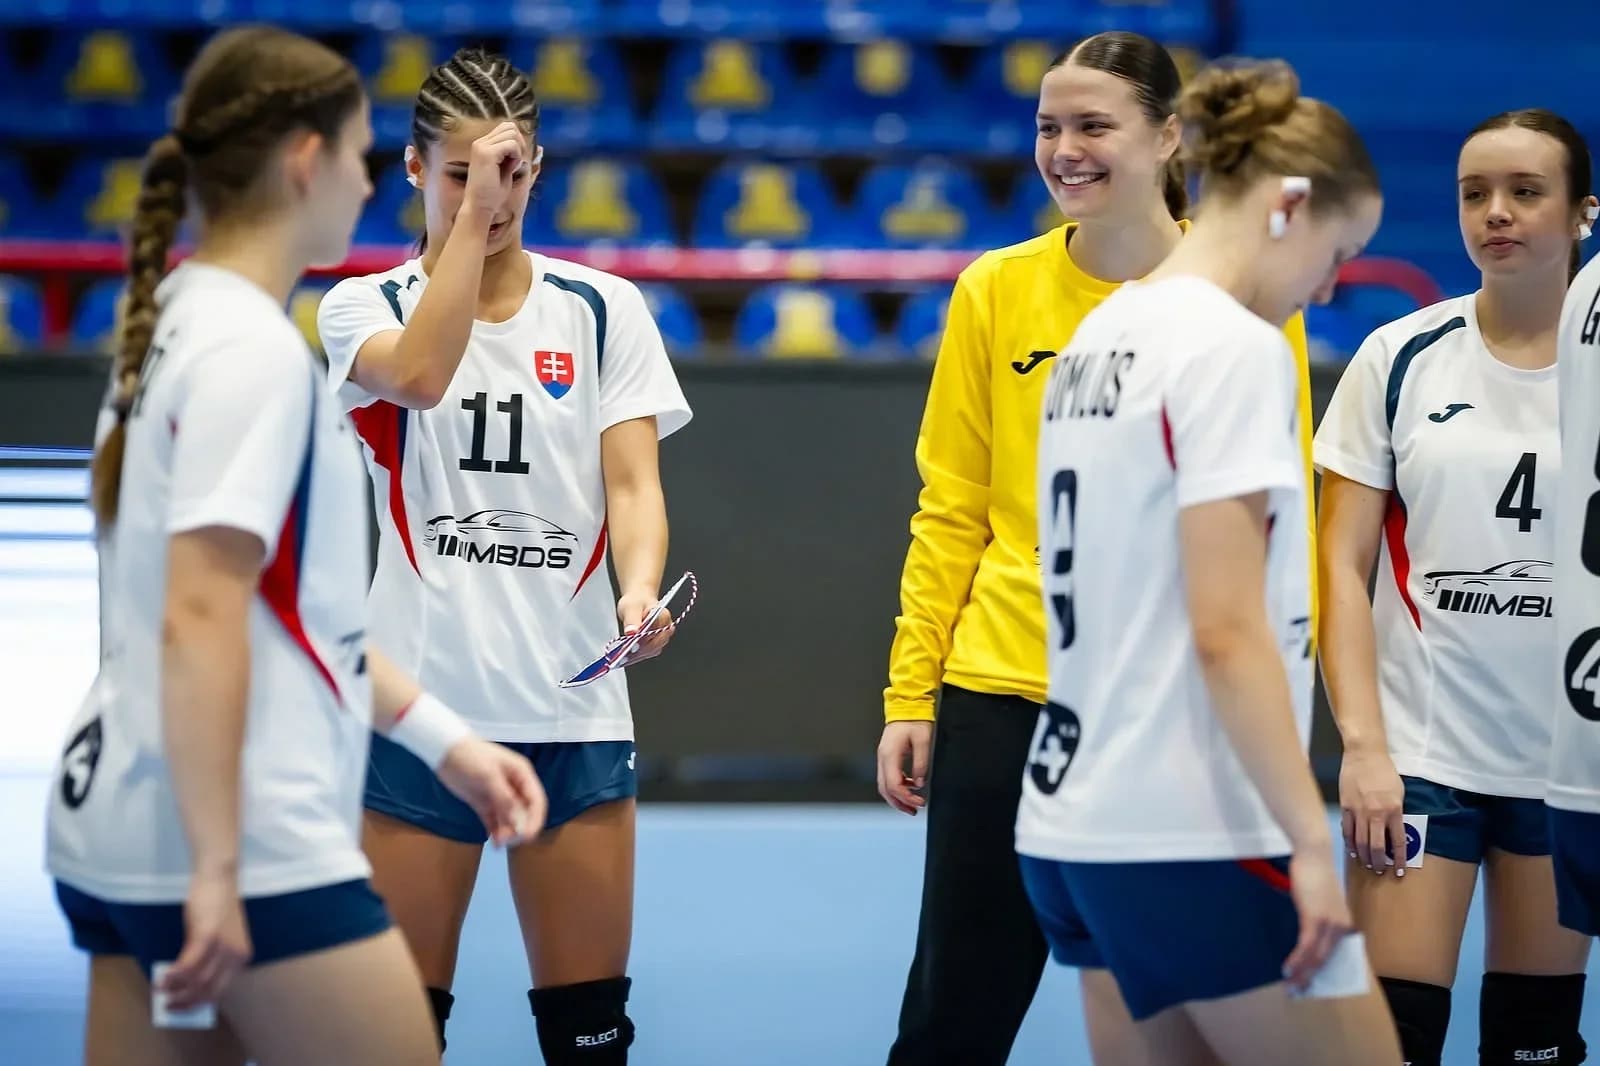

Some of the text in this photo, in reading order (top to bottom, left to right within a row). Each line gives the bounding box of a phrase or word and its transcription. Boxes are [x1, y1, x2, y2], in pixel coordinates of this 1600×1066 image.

[459, 391, 530, 475] 11
[1495, 452, 1542, 533] 4
[467, 542, 573, 569] MBDS
[1483, 593, 1553, 618] MB
[575, 1027, 619, 1047] SELECT
[1513, 1046, 1560, 1062] SELECT
